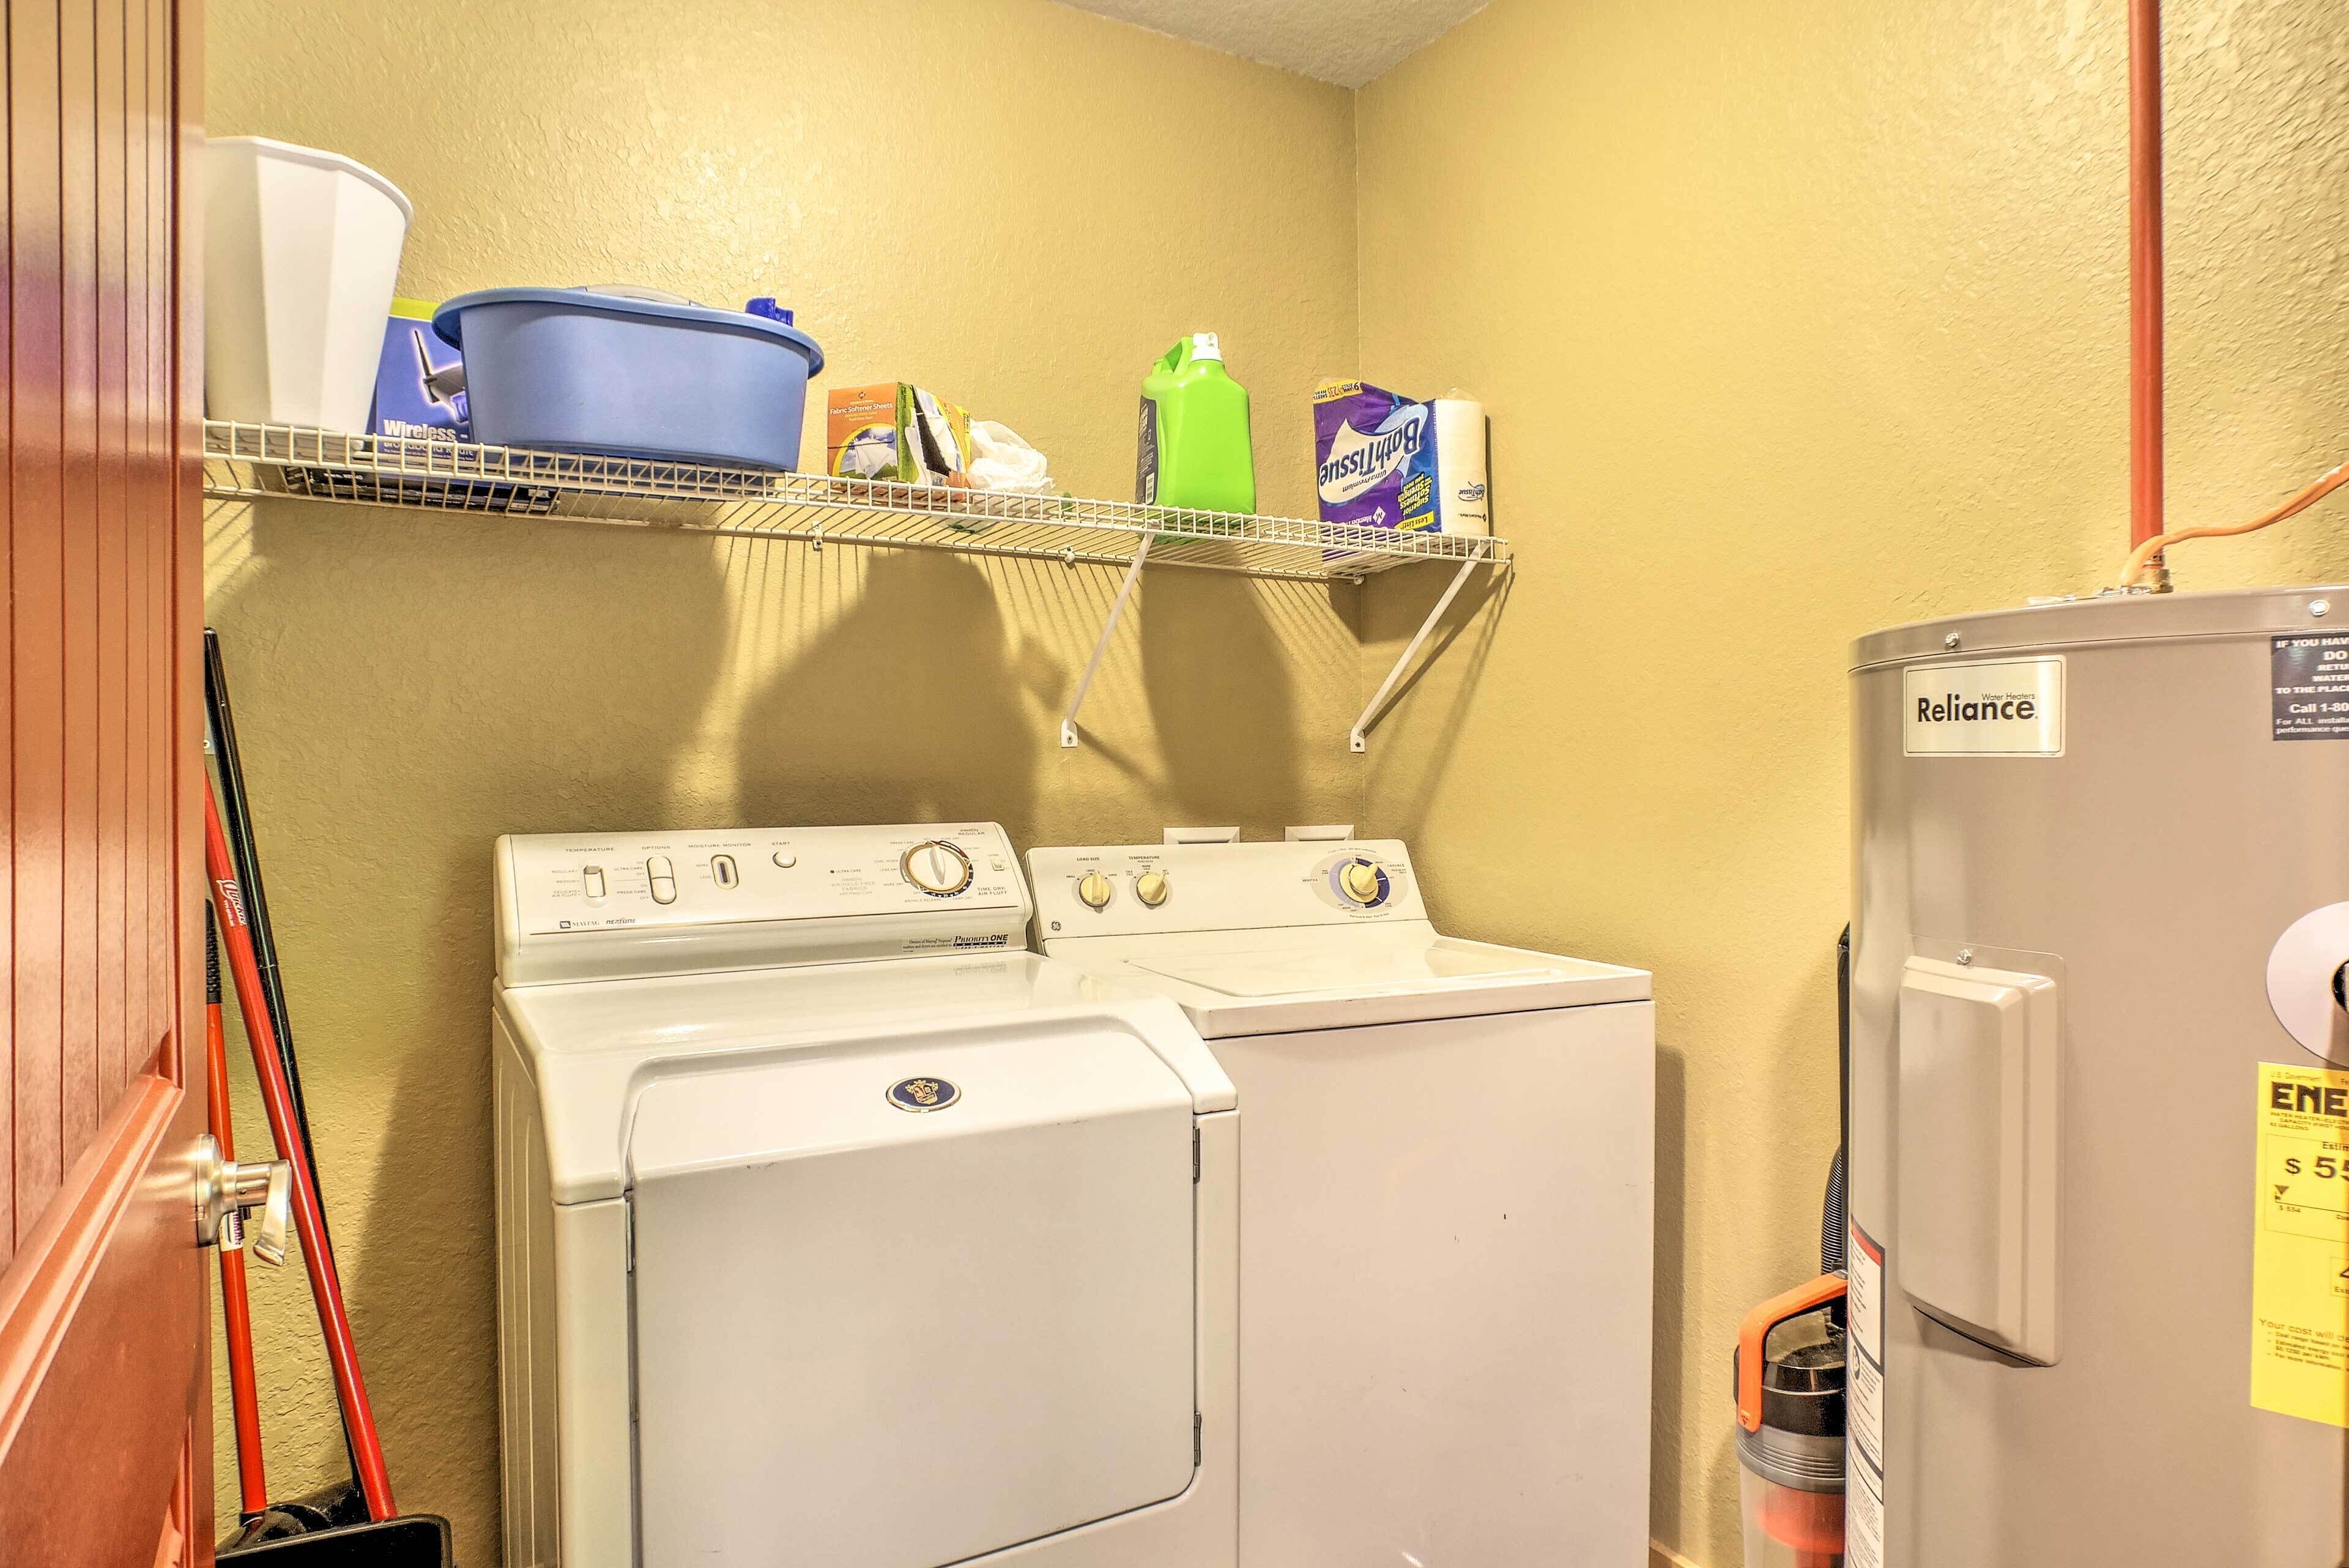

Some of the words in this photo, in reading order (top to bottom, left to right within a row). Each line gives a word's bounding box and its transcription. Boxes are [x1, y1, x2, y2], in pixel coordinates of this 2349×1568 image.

[384, 419, 456, 441] Wireless
[1398, 480, 1425, 502] Strength
[1399, 485, 1430, 510] Softness
[1415, 516, 1428, 525] Less
[2275, 640, 2290, 648] IF
[2291, 638, 2320, 647] YOU
[2323, 650, 2348, 661] DO
[1918, 693, 2035, 722] Reliance
[2289, 703, 2317, 713] Call
[2276, 726, 2331, 735] performance
[2271, 1081, 2348, 1118] ENE
[2285, 1157, 2301, 1176] $
[2260, 1318, 2285, 1330] Your
[2288, 1325, 2312, 1336] cost
